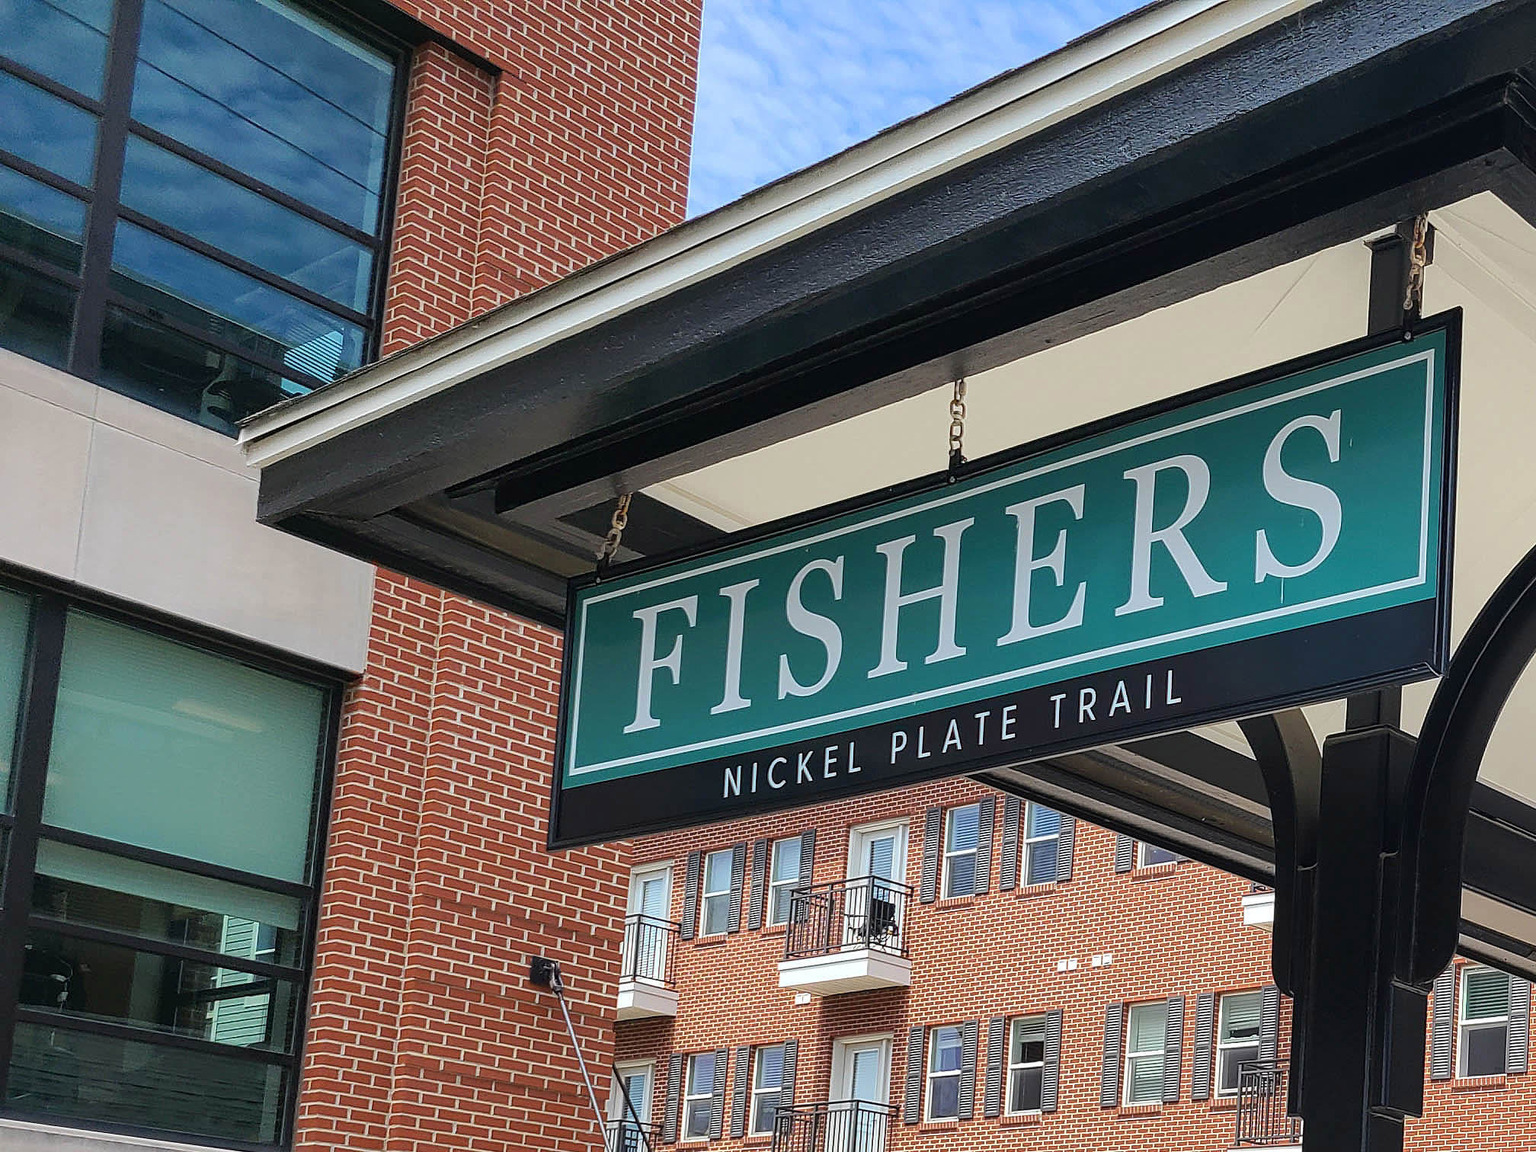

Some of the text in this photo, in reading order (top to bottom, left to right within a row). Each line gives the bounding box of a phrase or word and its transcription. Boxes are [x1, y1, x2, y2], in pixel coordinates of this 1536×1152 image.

[622, 408, 1344, 735] FISHERS
[723, 667, 1184, 799] NICKEL PLATE TRAIL
